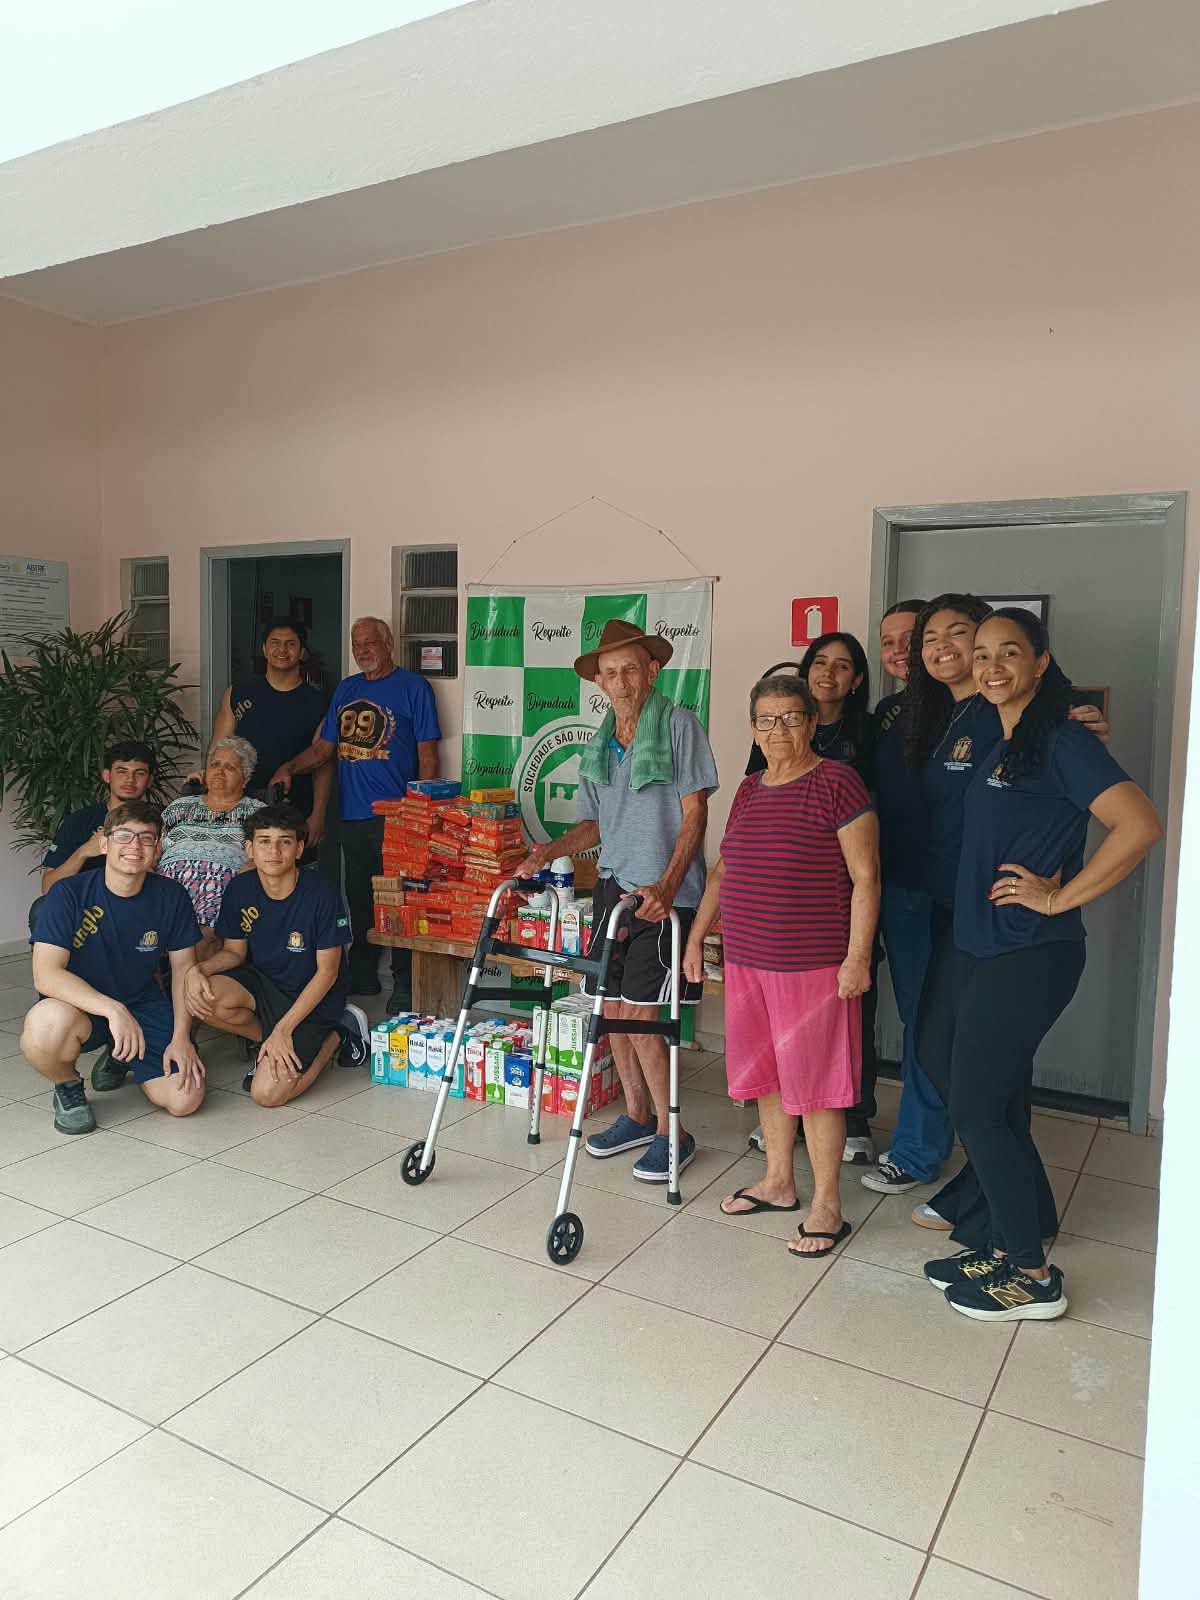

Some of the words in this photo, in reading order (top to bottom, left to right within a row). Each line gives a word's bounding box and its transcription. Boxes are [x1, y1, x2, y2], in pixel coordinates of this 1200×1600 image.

[532, 621, 572, 642] Respeito
[655, 620, 700, 641] Respeito
[473, 690, 514, 710] Respeito
[527, 692, 576, 711] Dignidade
[341, 710, 376, 737] 89
[524, 740, 555, 793] SOCIEDADE
[554, 730, 574, 746] SÃO
[73, 905, 104, 948] anglo
[240, 906, 259, 933] glo
